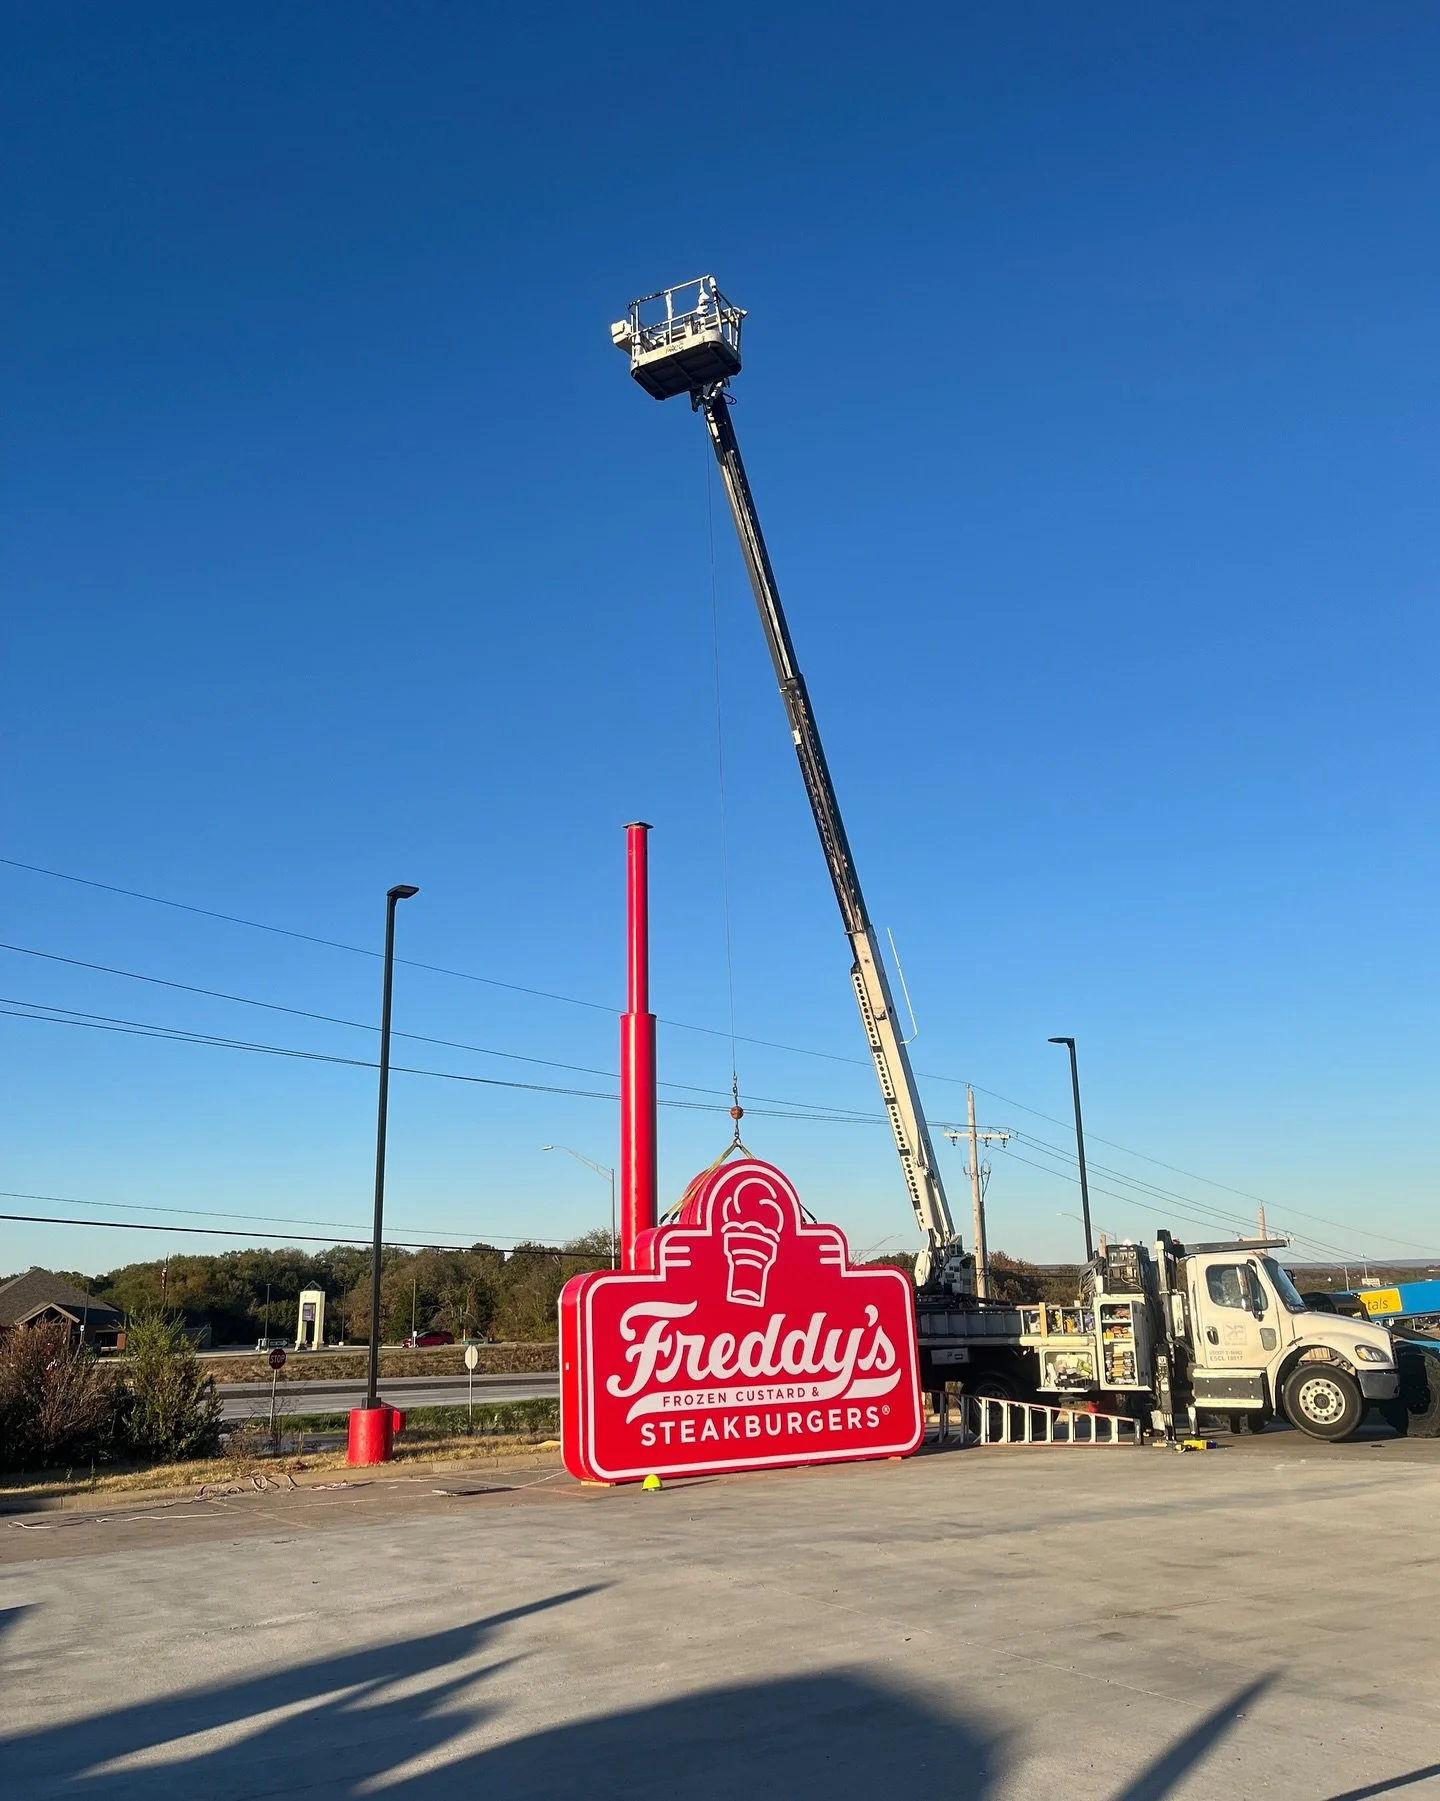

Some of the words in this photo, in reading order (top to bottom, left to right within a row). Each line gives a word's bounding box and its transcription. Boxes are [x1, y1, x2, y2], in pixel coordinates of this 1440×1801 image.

[270, 1354, 285, 1363] STOP
[606, 1300, 896, 1399] Freddy's
[662, 1393, 728, 1408] FROZEN
[735, 1387, 806, 1402] CUSTARD
[811, 1386, 820, 1397] &
